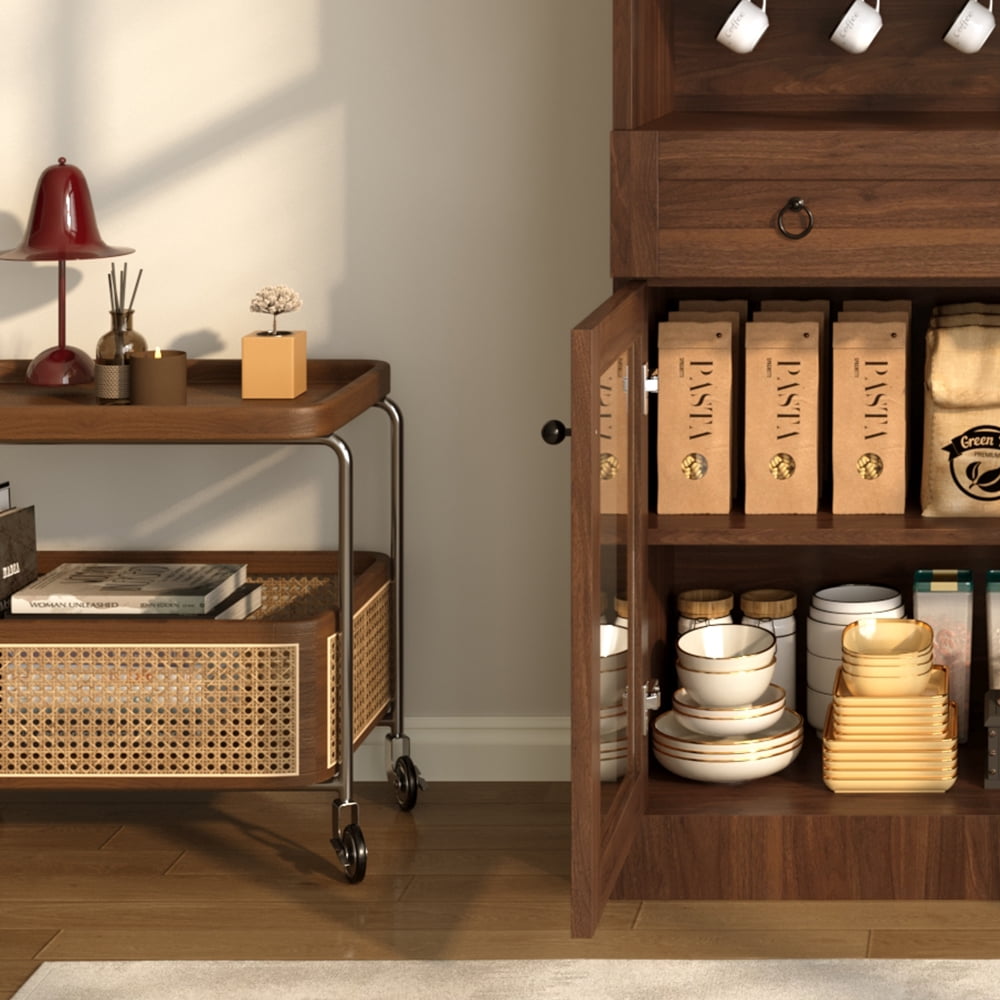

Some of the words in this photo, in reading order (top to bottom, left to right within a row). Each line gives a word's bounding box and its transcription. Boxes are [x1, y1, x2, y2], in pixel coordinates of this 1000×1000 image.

[689, 361, 713, 439] PASTA
[777, 361, 801, 439] PASTA
[864, 361, 888, 439] PASTA
[961, 435, 994, 449] Green
